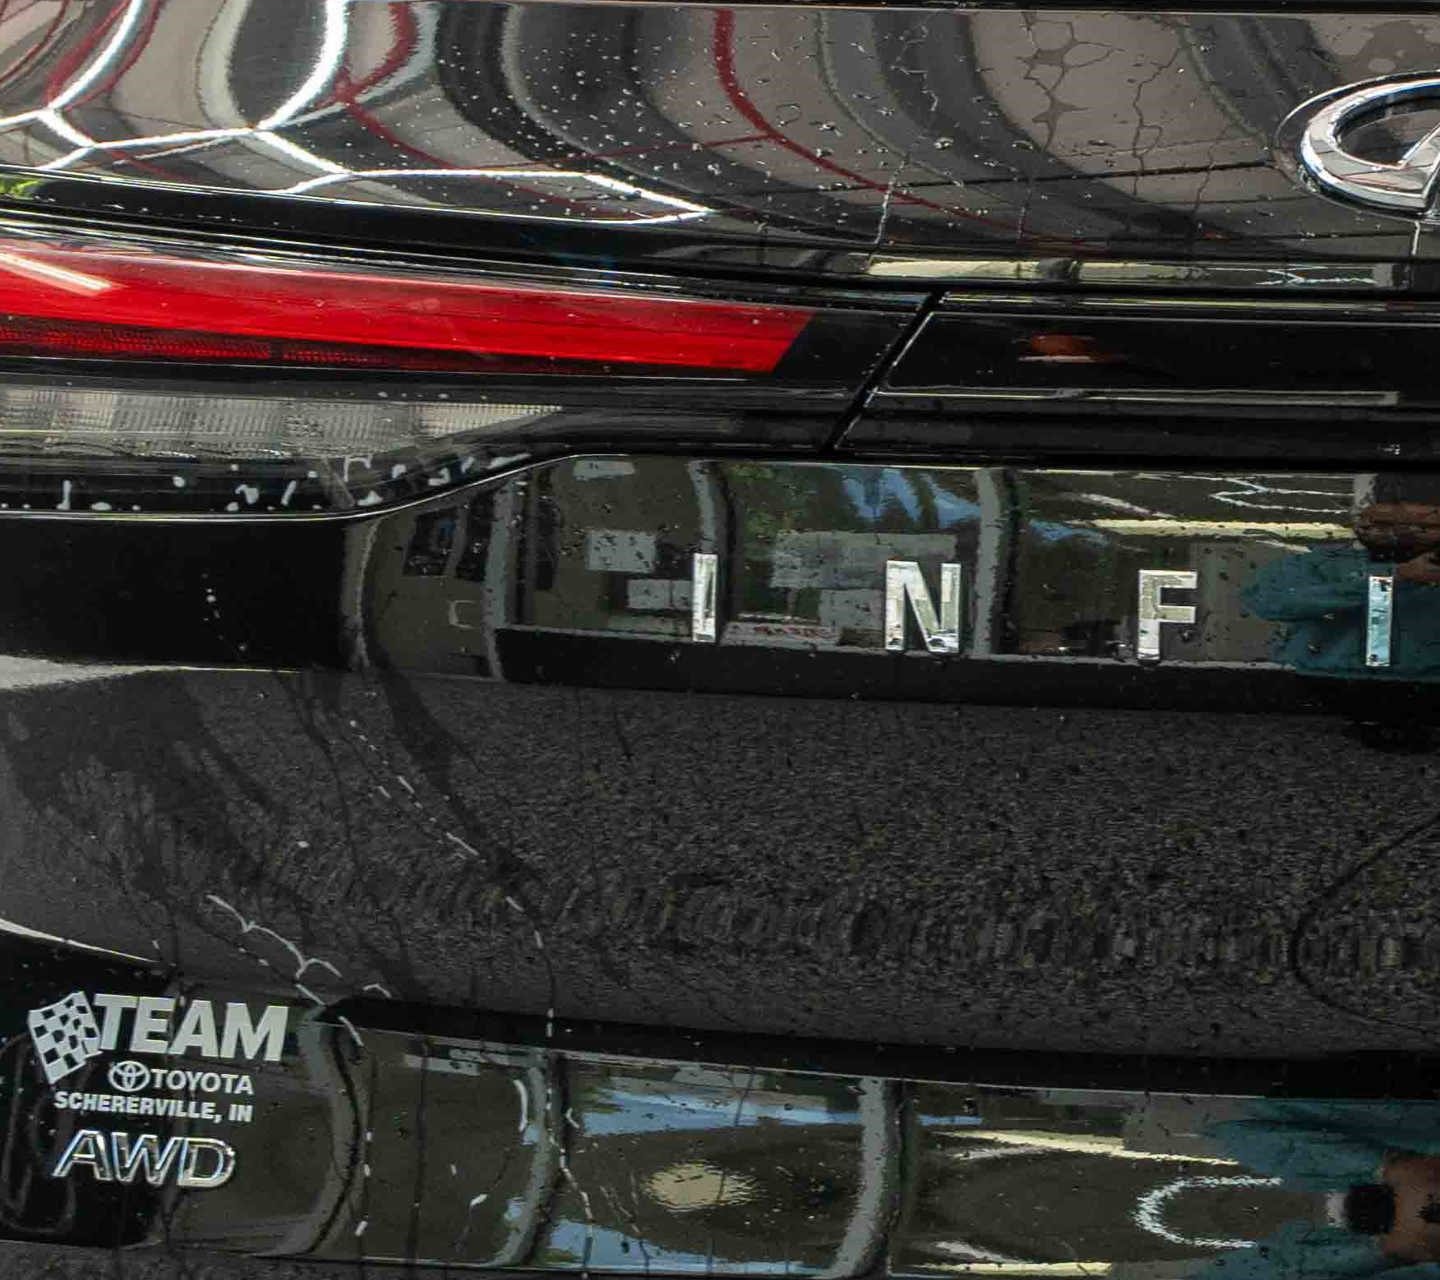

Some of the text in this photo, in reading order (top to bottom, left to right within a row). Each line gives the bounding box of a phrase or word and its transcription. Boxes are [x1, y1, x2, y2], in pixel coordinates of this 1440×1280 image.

[94, 993, 289, 1061] TEAM
[151, 1068, 254, 1095] TOYOTA
[54, 1091, 254, 1123] SCHERERVILLE, IN
[52, 1129, 237, 1188] AWD
